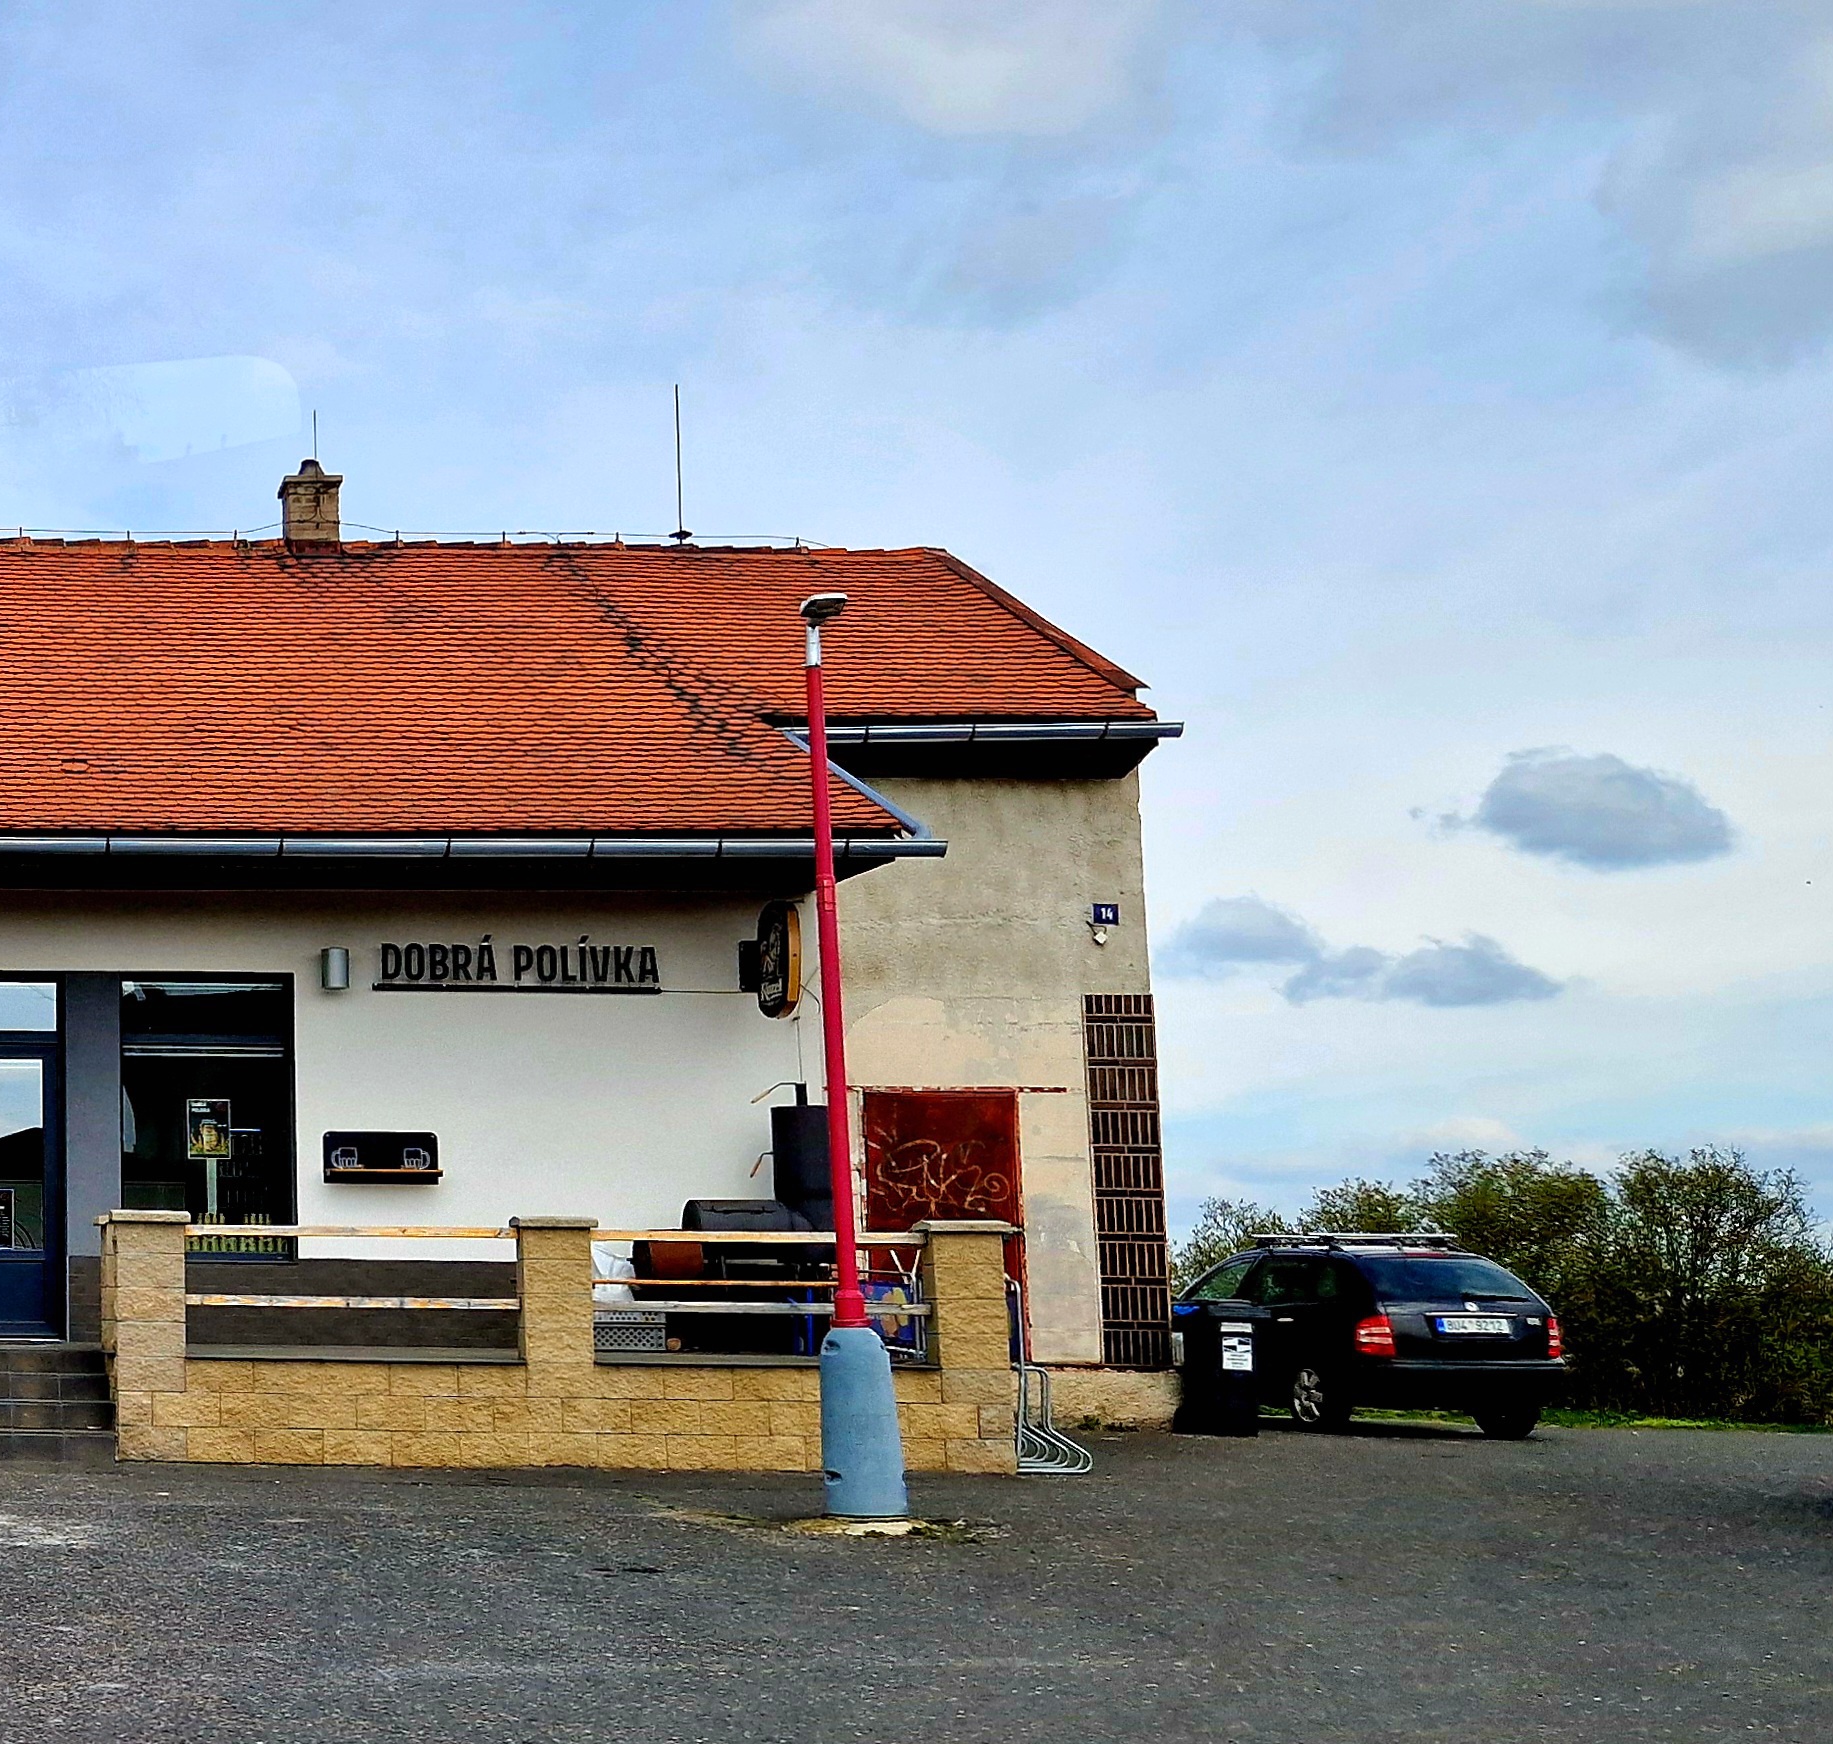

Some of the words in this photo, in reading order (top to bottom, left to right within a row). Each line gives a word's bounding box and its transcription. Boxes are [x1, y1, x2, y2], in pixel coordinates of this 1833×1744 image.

[1101, 907, 1113, 920] 14
[380, 934, 498, 982] DOBRÁ
[512, 935, 660, 983] POLÍVKA
